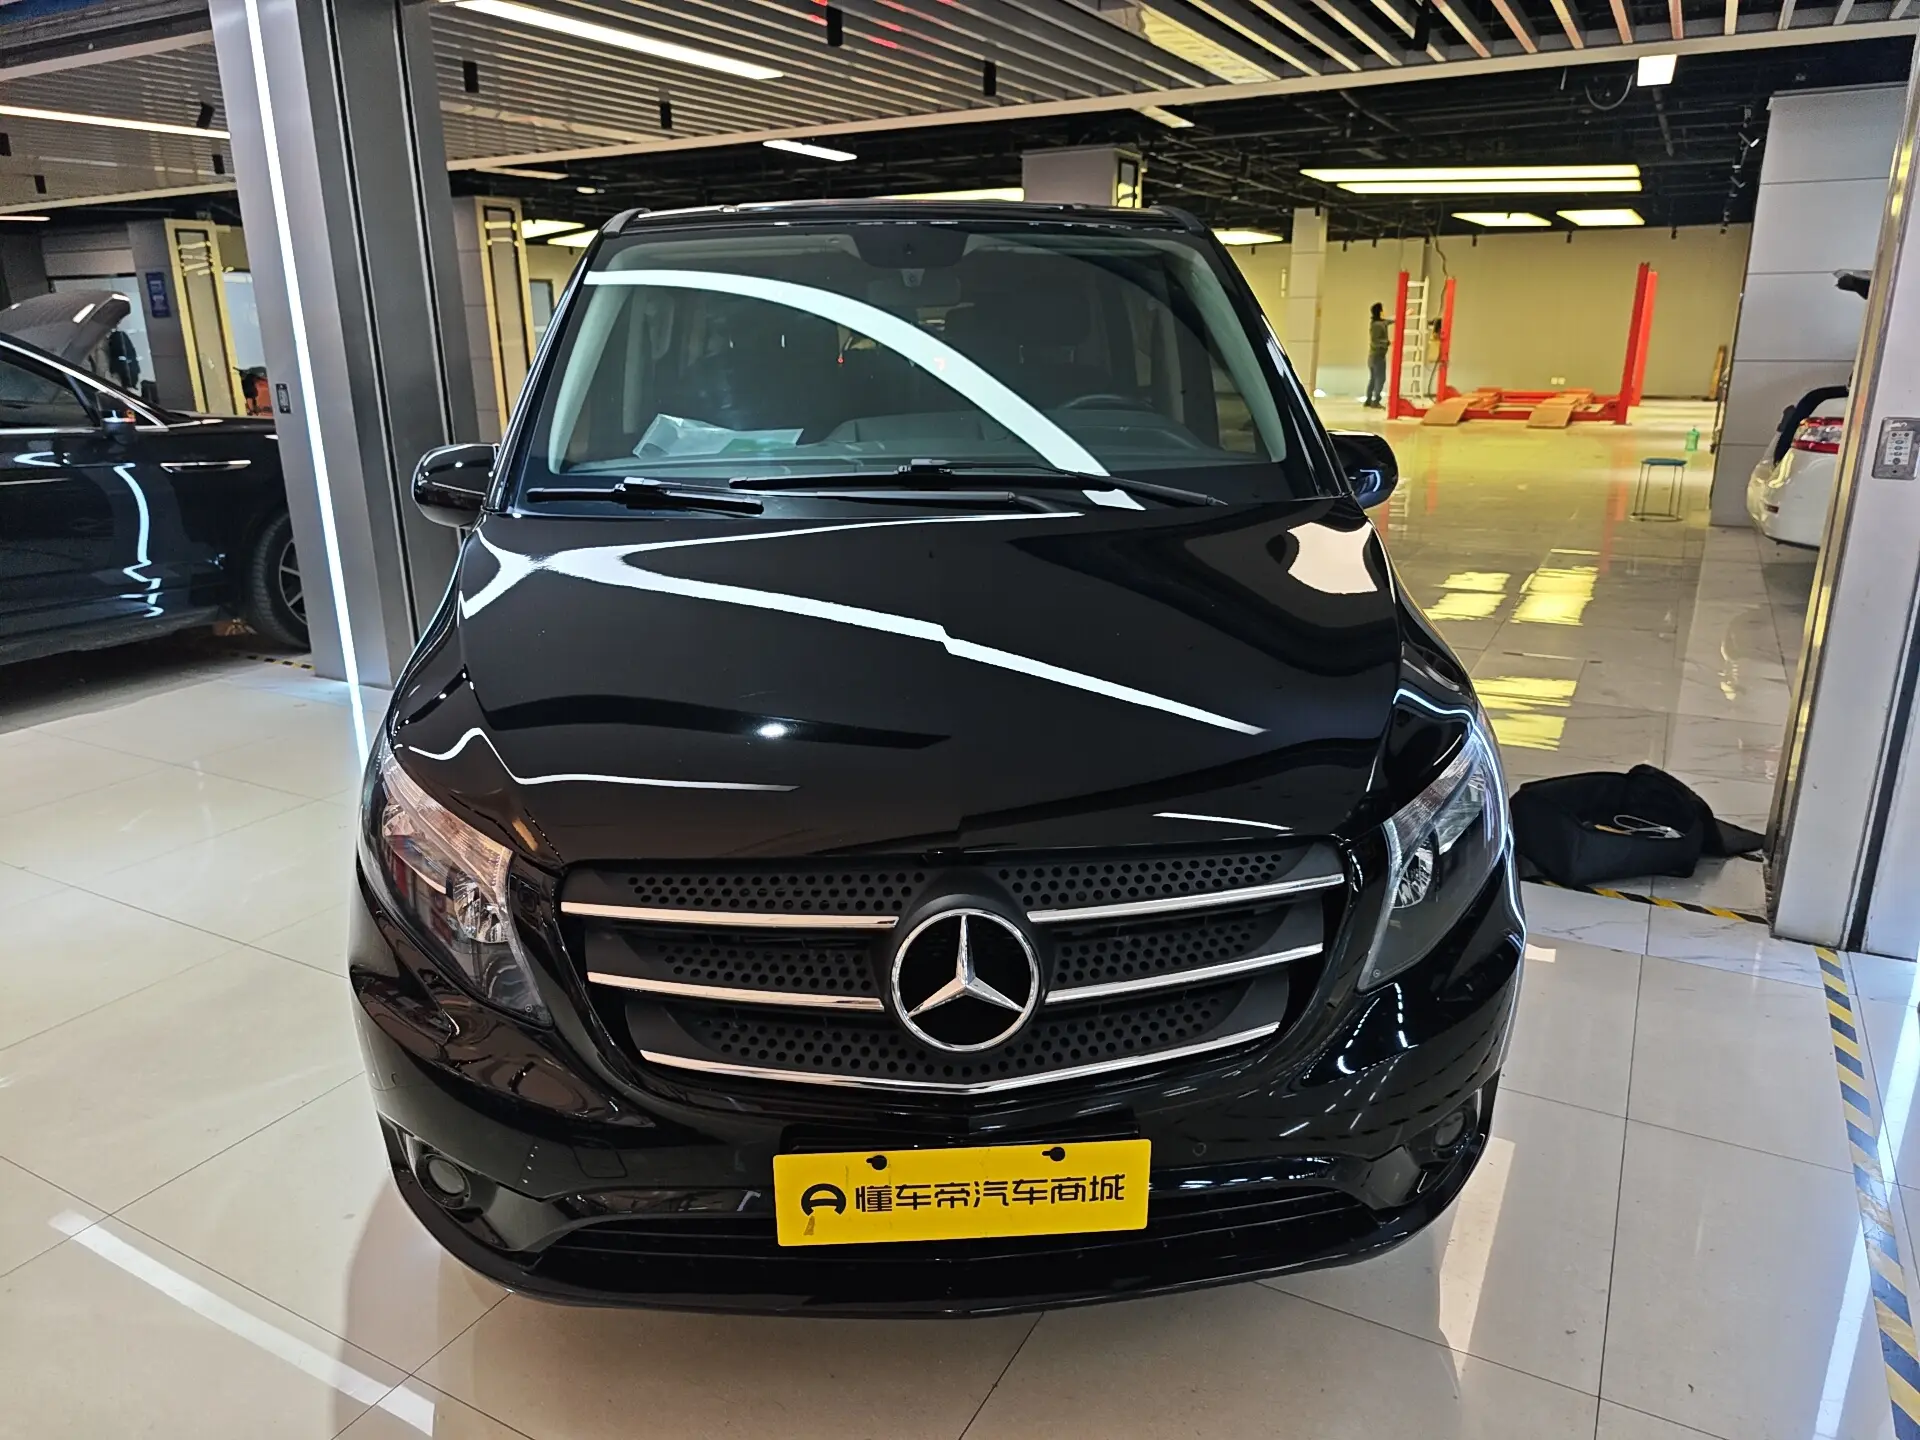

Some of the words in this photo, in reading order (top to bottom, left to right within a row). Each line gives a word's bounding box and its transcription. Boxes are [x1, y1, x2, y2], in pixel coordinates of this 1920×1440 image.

[854, 1173, 1126, 1213] 懂车帝汽车商城
